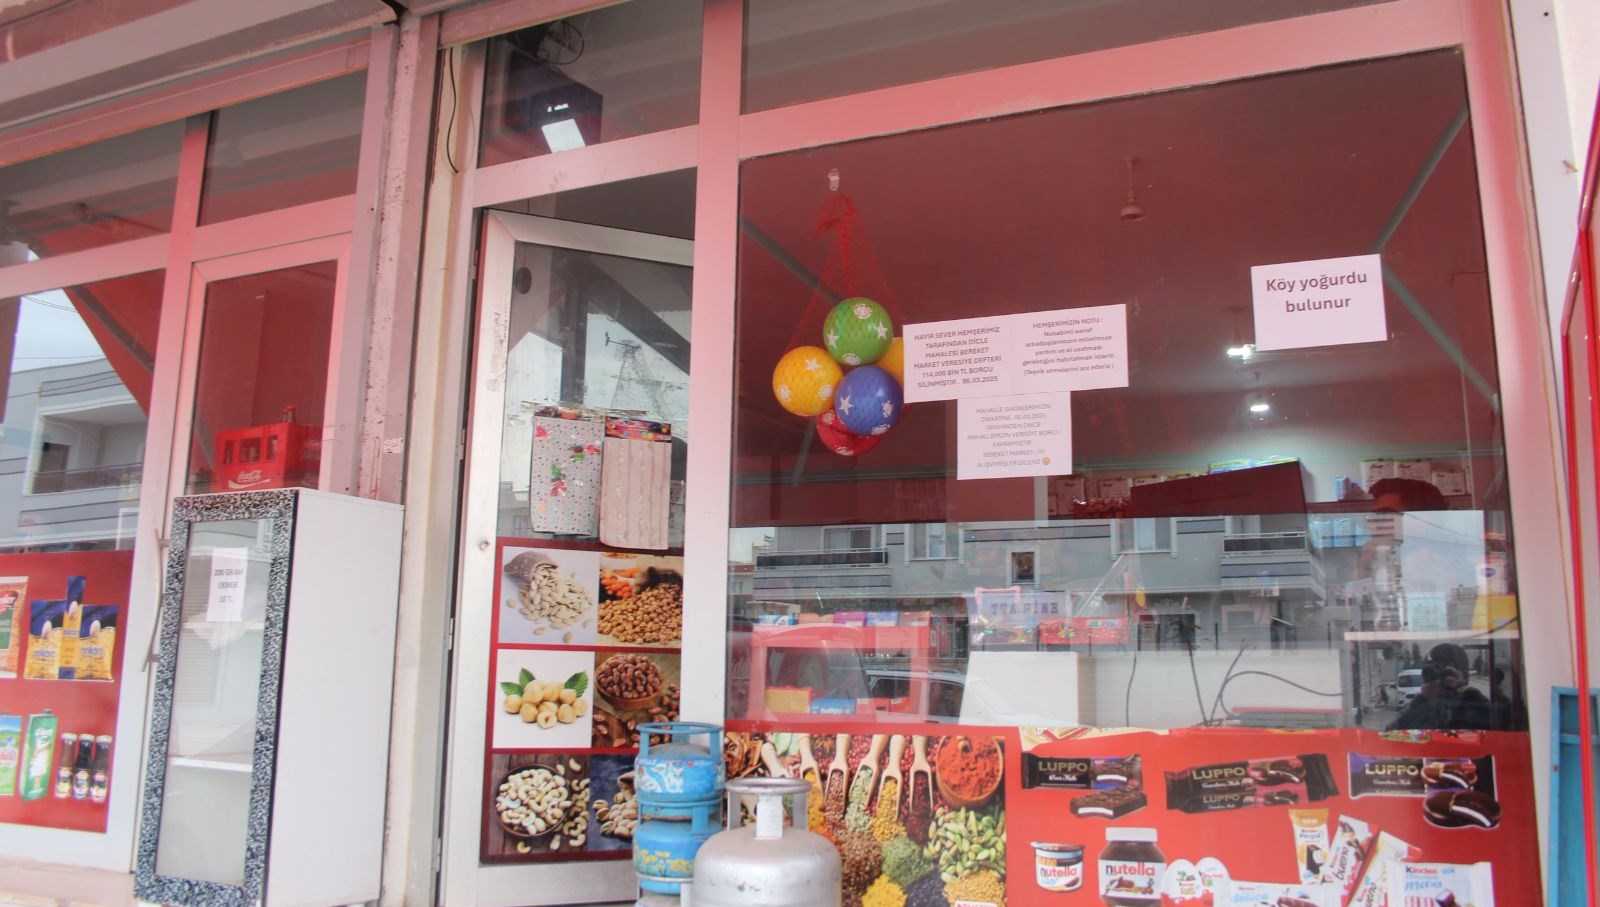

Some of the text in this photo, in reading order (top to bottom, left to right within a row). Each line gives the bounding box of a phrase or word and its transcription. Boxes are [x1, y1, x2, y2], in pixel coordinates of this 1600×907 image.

[1266, 271, 1367, 292] Köy yoğurdu
[1286, 298, 1351, 312] bulunur
[1038, 760, 1088, 772] LUPPO
[1365, 763, 1419, 776] LUPPO
[1192, 767, 1246, 780] LUPPO
[1202, 793, 1240, 803] LUPPO
[1040, 866, 1077, 878] nutella
[1105, 862, 1155, 876] nutella
